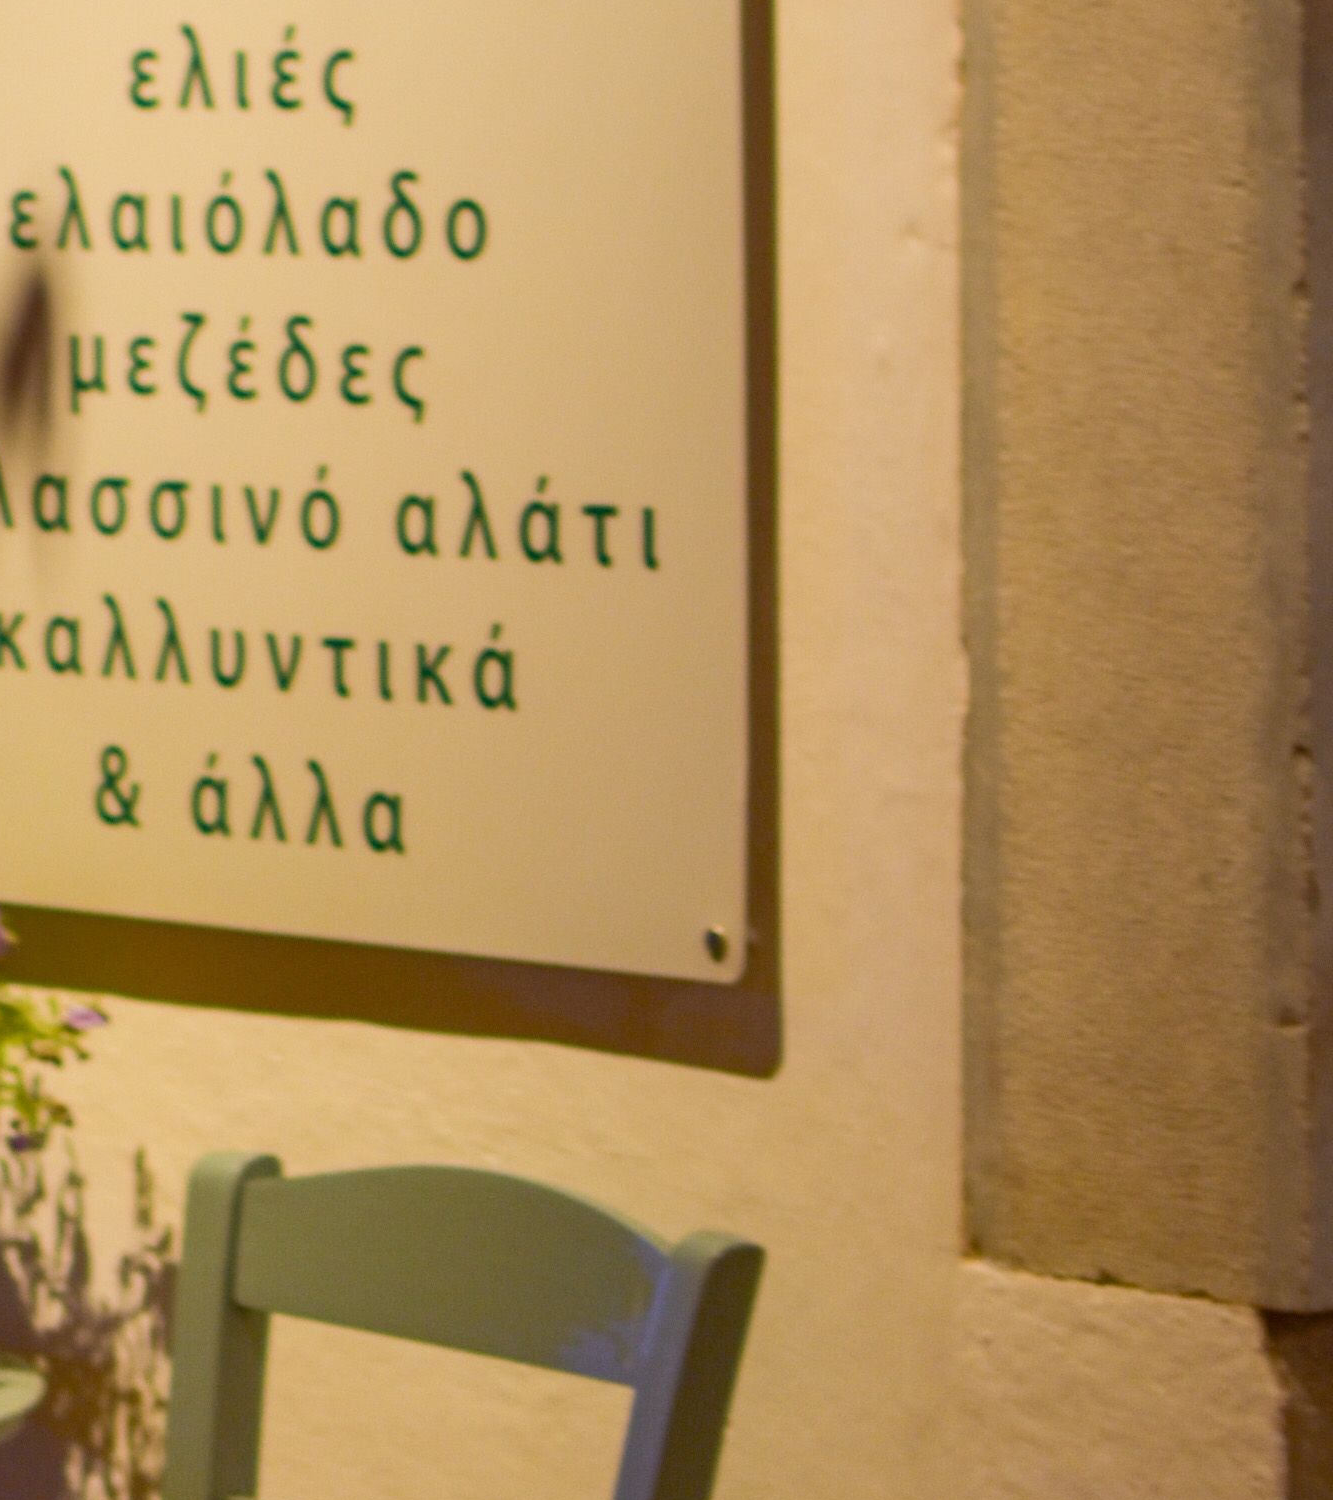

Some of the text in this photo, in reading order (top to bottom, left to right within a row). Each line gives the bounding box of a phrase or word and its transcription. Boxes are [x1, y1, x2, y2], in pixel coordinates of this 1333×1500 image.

[129, 24, 356, 127] ελιές
[7, 166, 490, 262] ελαιόλαδο
[68, 312, 428, 424] μεζέδες
[396, 470, 662, 571] αλάτι
[93, 744, 408, 857] & άλλα
